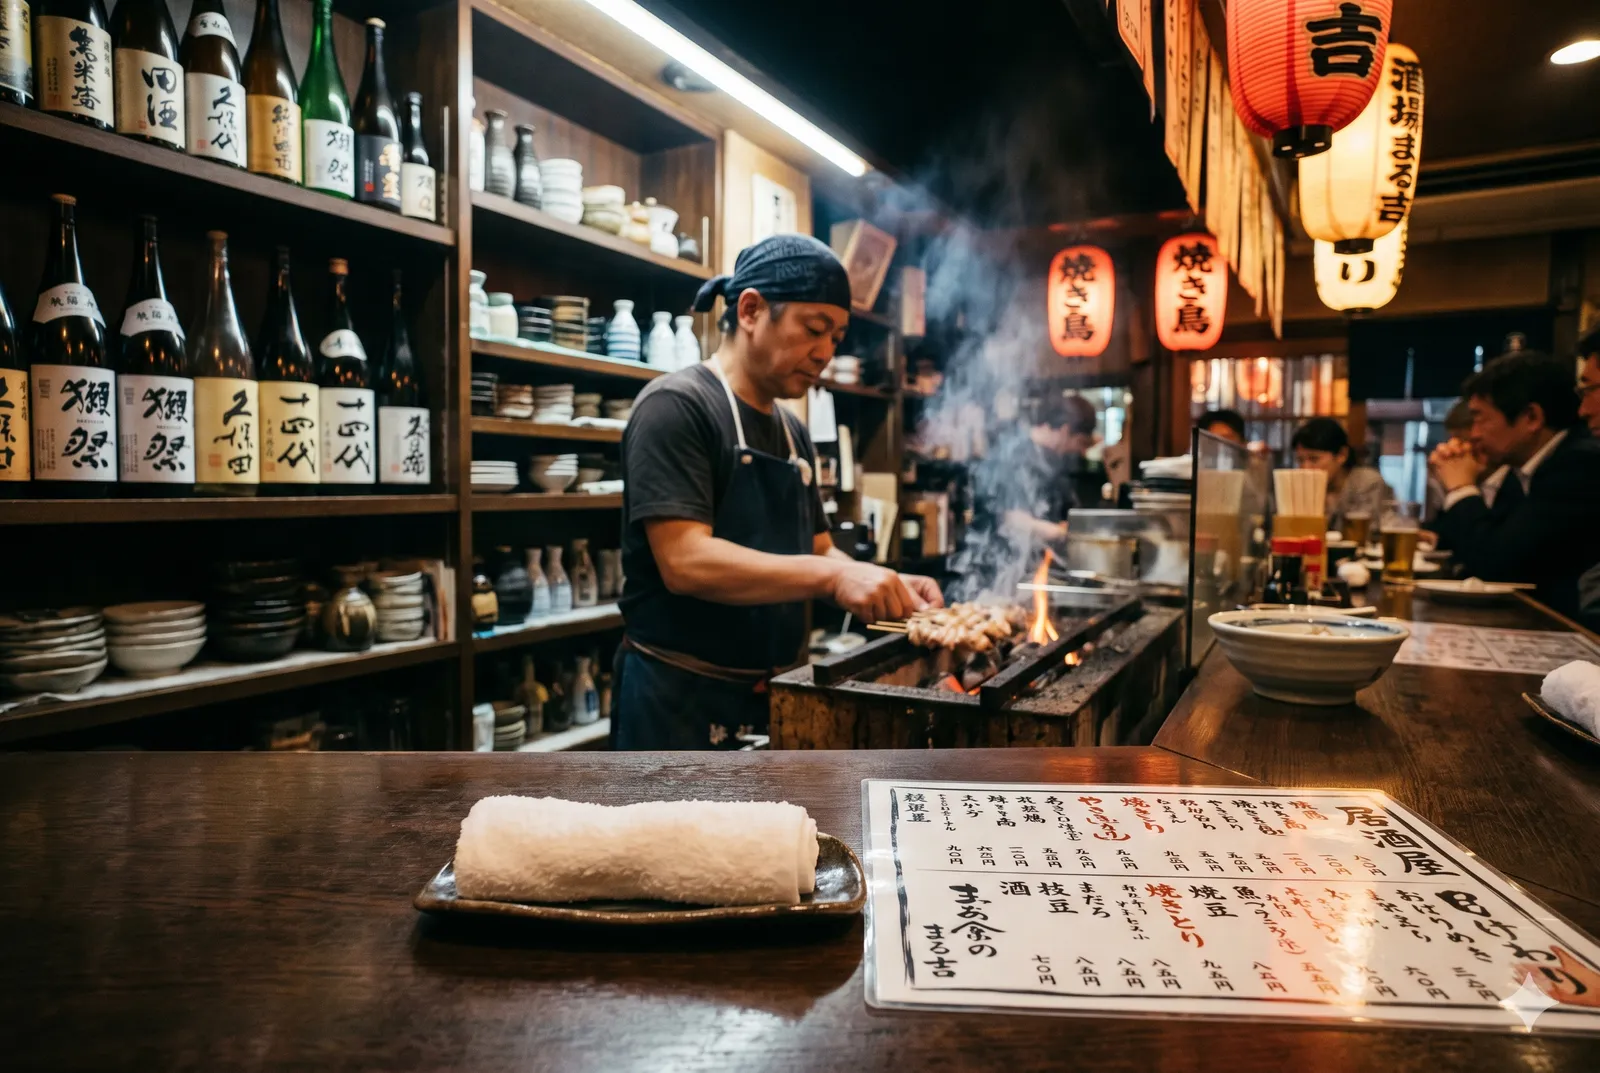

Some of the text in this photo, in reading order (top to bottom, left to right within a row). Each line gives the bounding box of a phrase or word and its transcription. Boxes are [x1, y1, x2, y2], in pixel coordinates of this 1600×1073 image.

[1306, 2, 1382, 77] 吉
[1379, 57, 1424, 223] 酒場まる吉
[1061, 252, 1095, 341] 焼き鳥
[1173, 241, 1213, 333] 焼き鳥
[60, 378, 112, 469] 獺祭
[142, 387, 188, 471] 獺祭
[213, 388, 252, 475] 久保田
[277, 392, 316, 474] 十四代
[334, 397, 370, 474] 十四代
[1335, 806, 1461, 877] 居酒屋
[1000, 881, 1031, 896] 酒
[1144, 883, 1204, 948] 焼きとり
[1188, 884, 1239, 918] 焼豆
[923, 923, 958, 978] まる吉
[1031, 954, 1057, 985] 七〇円
[1075, 955, 1101, 987] 八五円
[1117, 957, 1146, 989] 八五円
[1151, 958, 1182, 990] 八五円
[1200, 958, 1235, 992] 九五円
[1402, 965, 1450, 1000] 六〇円
